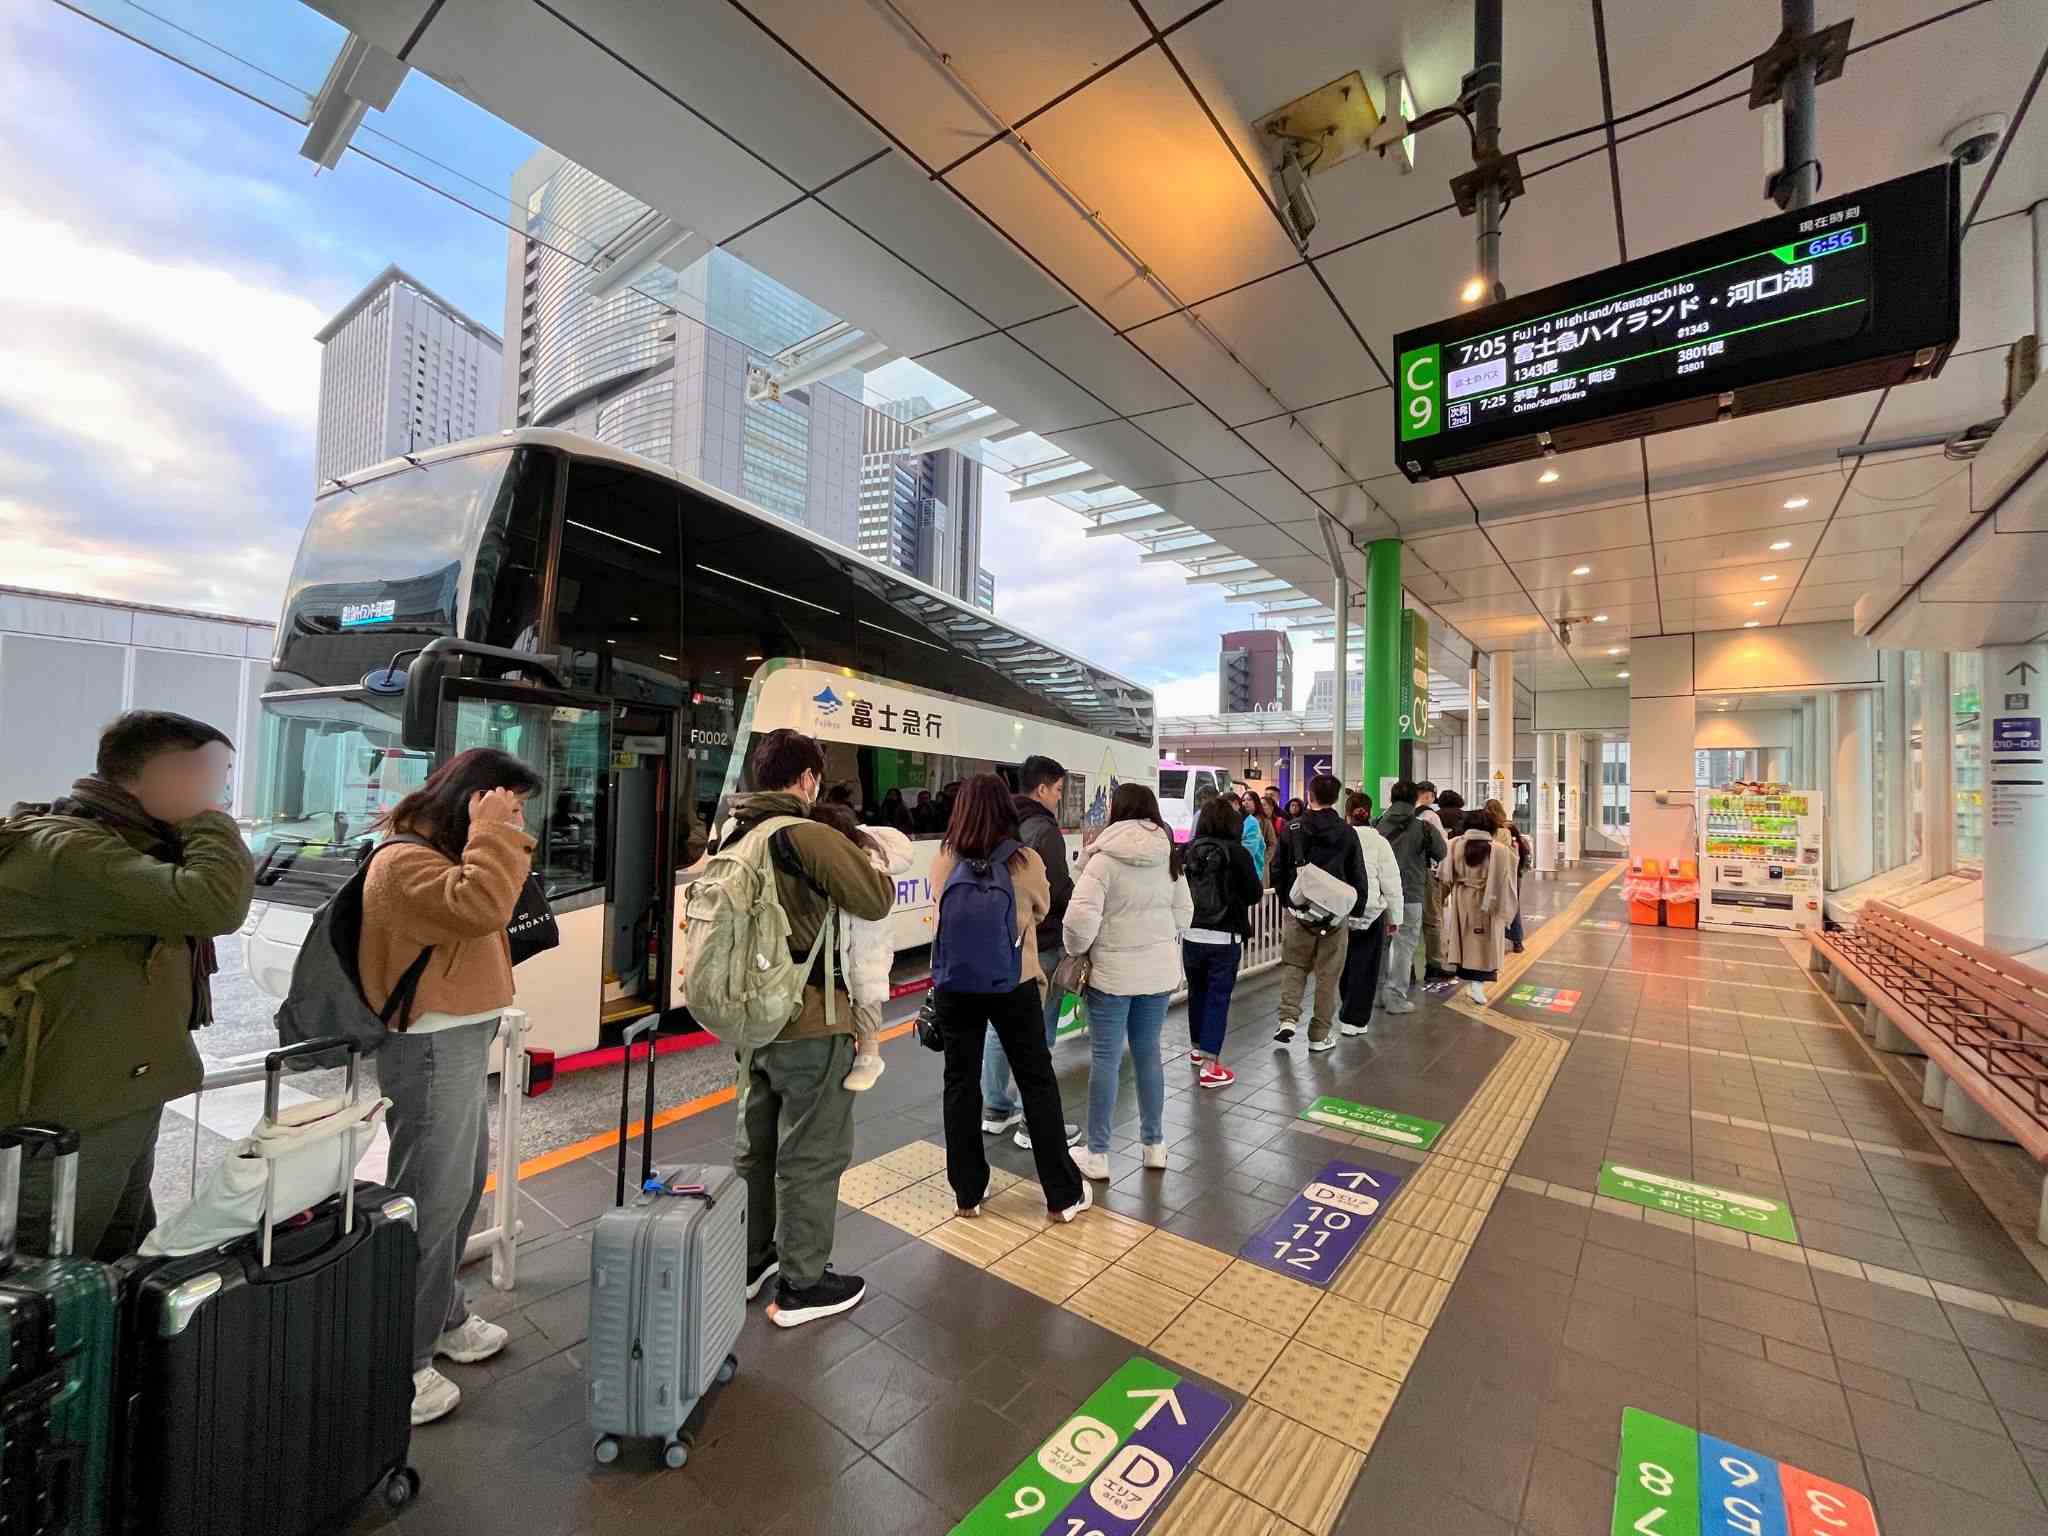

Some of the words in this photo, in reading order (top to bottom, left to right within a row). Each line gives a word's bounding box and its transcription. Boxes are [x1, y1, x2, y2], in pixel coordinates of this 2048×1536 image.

[1799, 205, 1861, 233] 現在時刻
[1808, 231, 1854, 256] 6:56
[1512, 322, 1550, 342] Fuji-Q
[1555, 283, 1695, 331] Highland/Kawaguchiko
[1513, 264, 1813, 364] 富士急ハイランド・河口湖
[1460, 336, 1507, 364] 7:05
[1677, 340, 1725, 363] 3801便
[1407, 357, 1434, 391] C
[1513, 359, 1559, 382] 1343便
[1410, 396, 1433, 429] 9
[1480, 394, 1507, 411] 7:25
[1451, 416, 1468, 426] 2nd
[851, 699, 942, 739] 富士急行
[691, 729, 728, 746] F0002
[1316, 1188, 1335, 1199] D
[1308, 1206, 1351, 1230] 10
[1293, 1223, 1331, 1248] 11
[1274, 1241, 1320, 1271] 12
[1070, 1427, 1105, 1455] C
[1051, 1447, 1087, 1468] エリア
[1120, 1453, 1160, 1488] D
[1103, 1478, 1143, 1503] エリア
[1638, 1462, 1674, 1497] 8
[1005, 1486, 1046, 1520] 9
[1102, 1492, 1128, 1511] area
[1806, 1489, 1848, 1528] 3
[1723, 1496, 1763, 1536] 5
